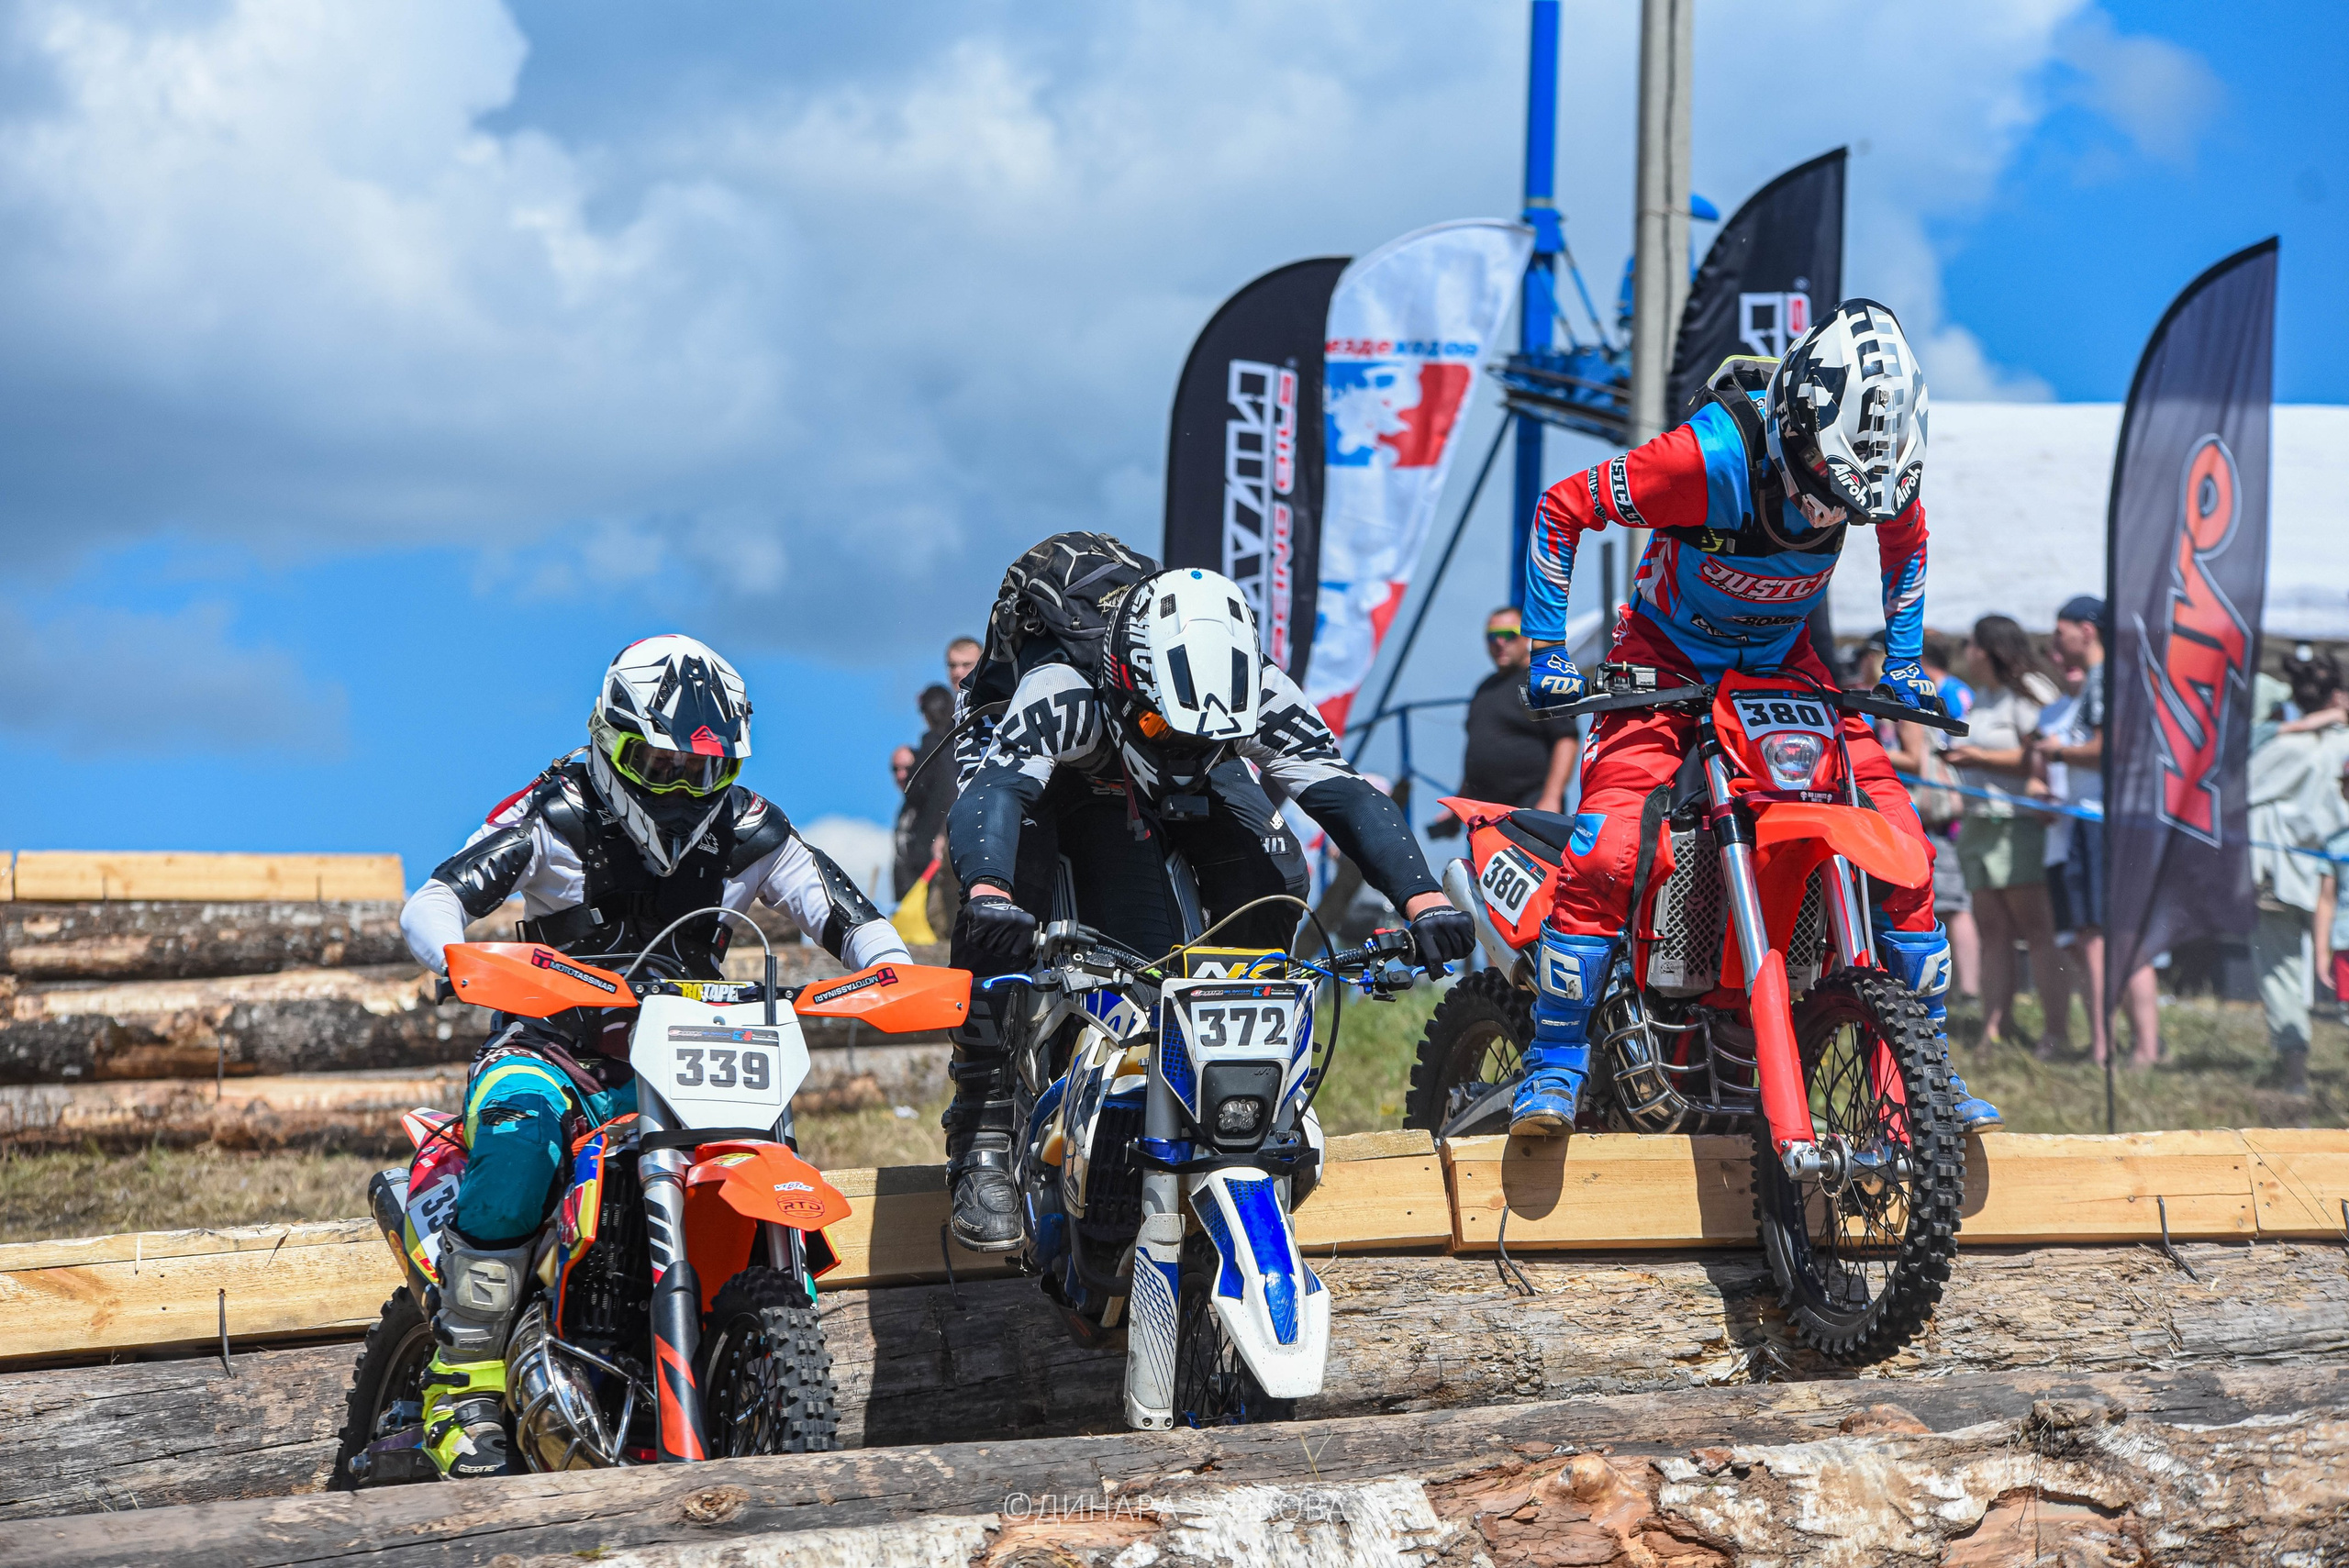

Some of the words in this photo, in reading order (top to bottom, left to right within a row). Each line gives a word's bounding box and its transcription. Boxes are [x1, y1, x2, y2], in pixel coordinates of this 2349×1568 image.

[1612, 451, 1648, 526] USTCAT
[1830, 462, 1869, 510] Airoh
[1894, 465, 1921, 510] Airoh
[1709, 580, 1756, 601] RACING
[2132, 431, 2254, 850] KAYO
[1541, 675, 1583, 695] FOX
[1907, 679, 1938, 698] FOX
[1741, 702, 1825, 728] 380
[1482, 856, 1531, 911] 380
[550, 961, 617, 994] MOTOTASSINARI
[815, 974, 879, 1003] MOTOTASSINARI
[1198, 1006, 1288, 1048] 372
[676, 1048, 770, 1091] 339
[421, 1184, 459, 1235] 33
[784, 1200, 821, 1211] RTD
